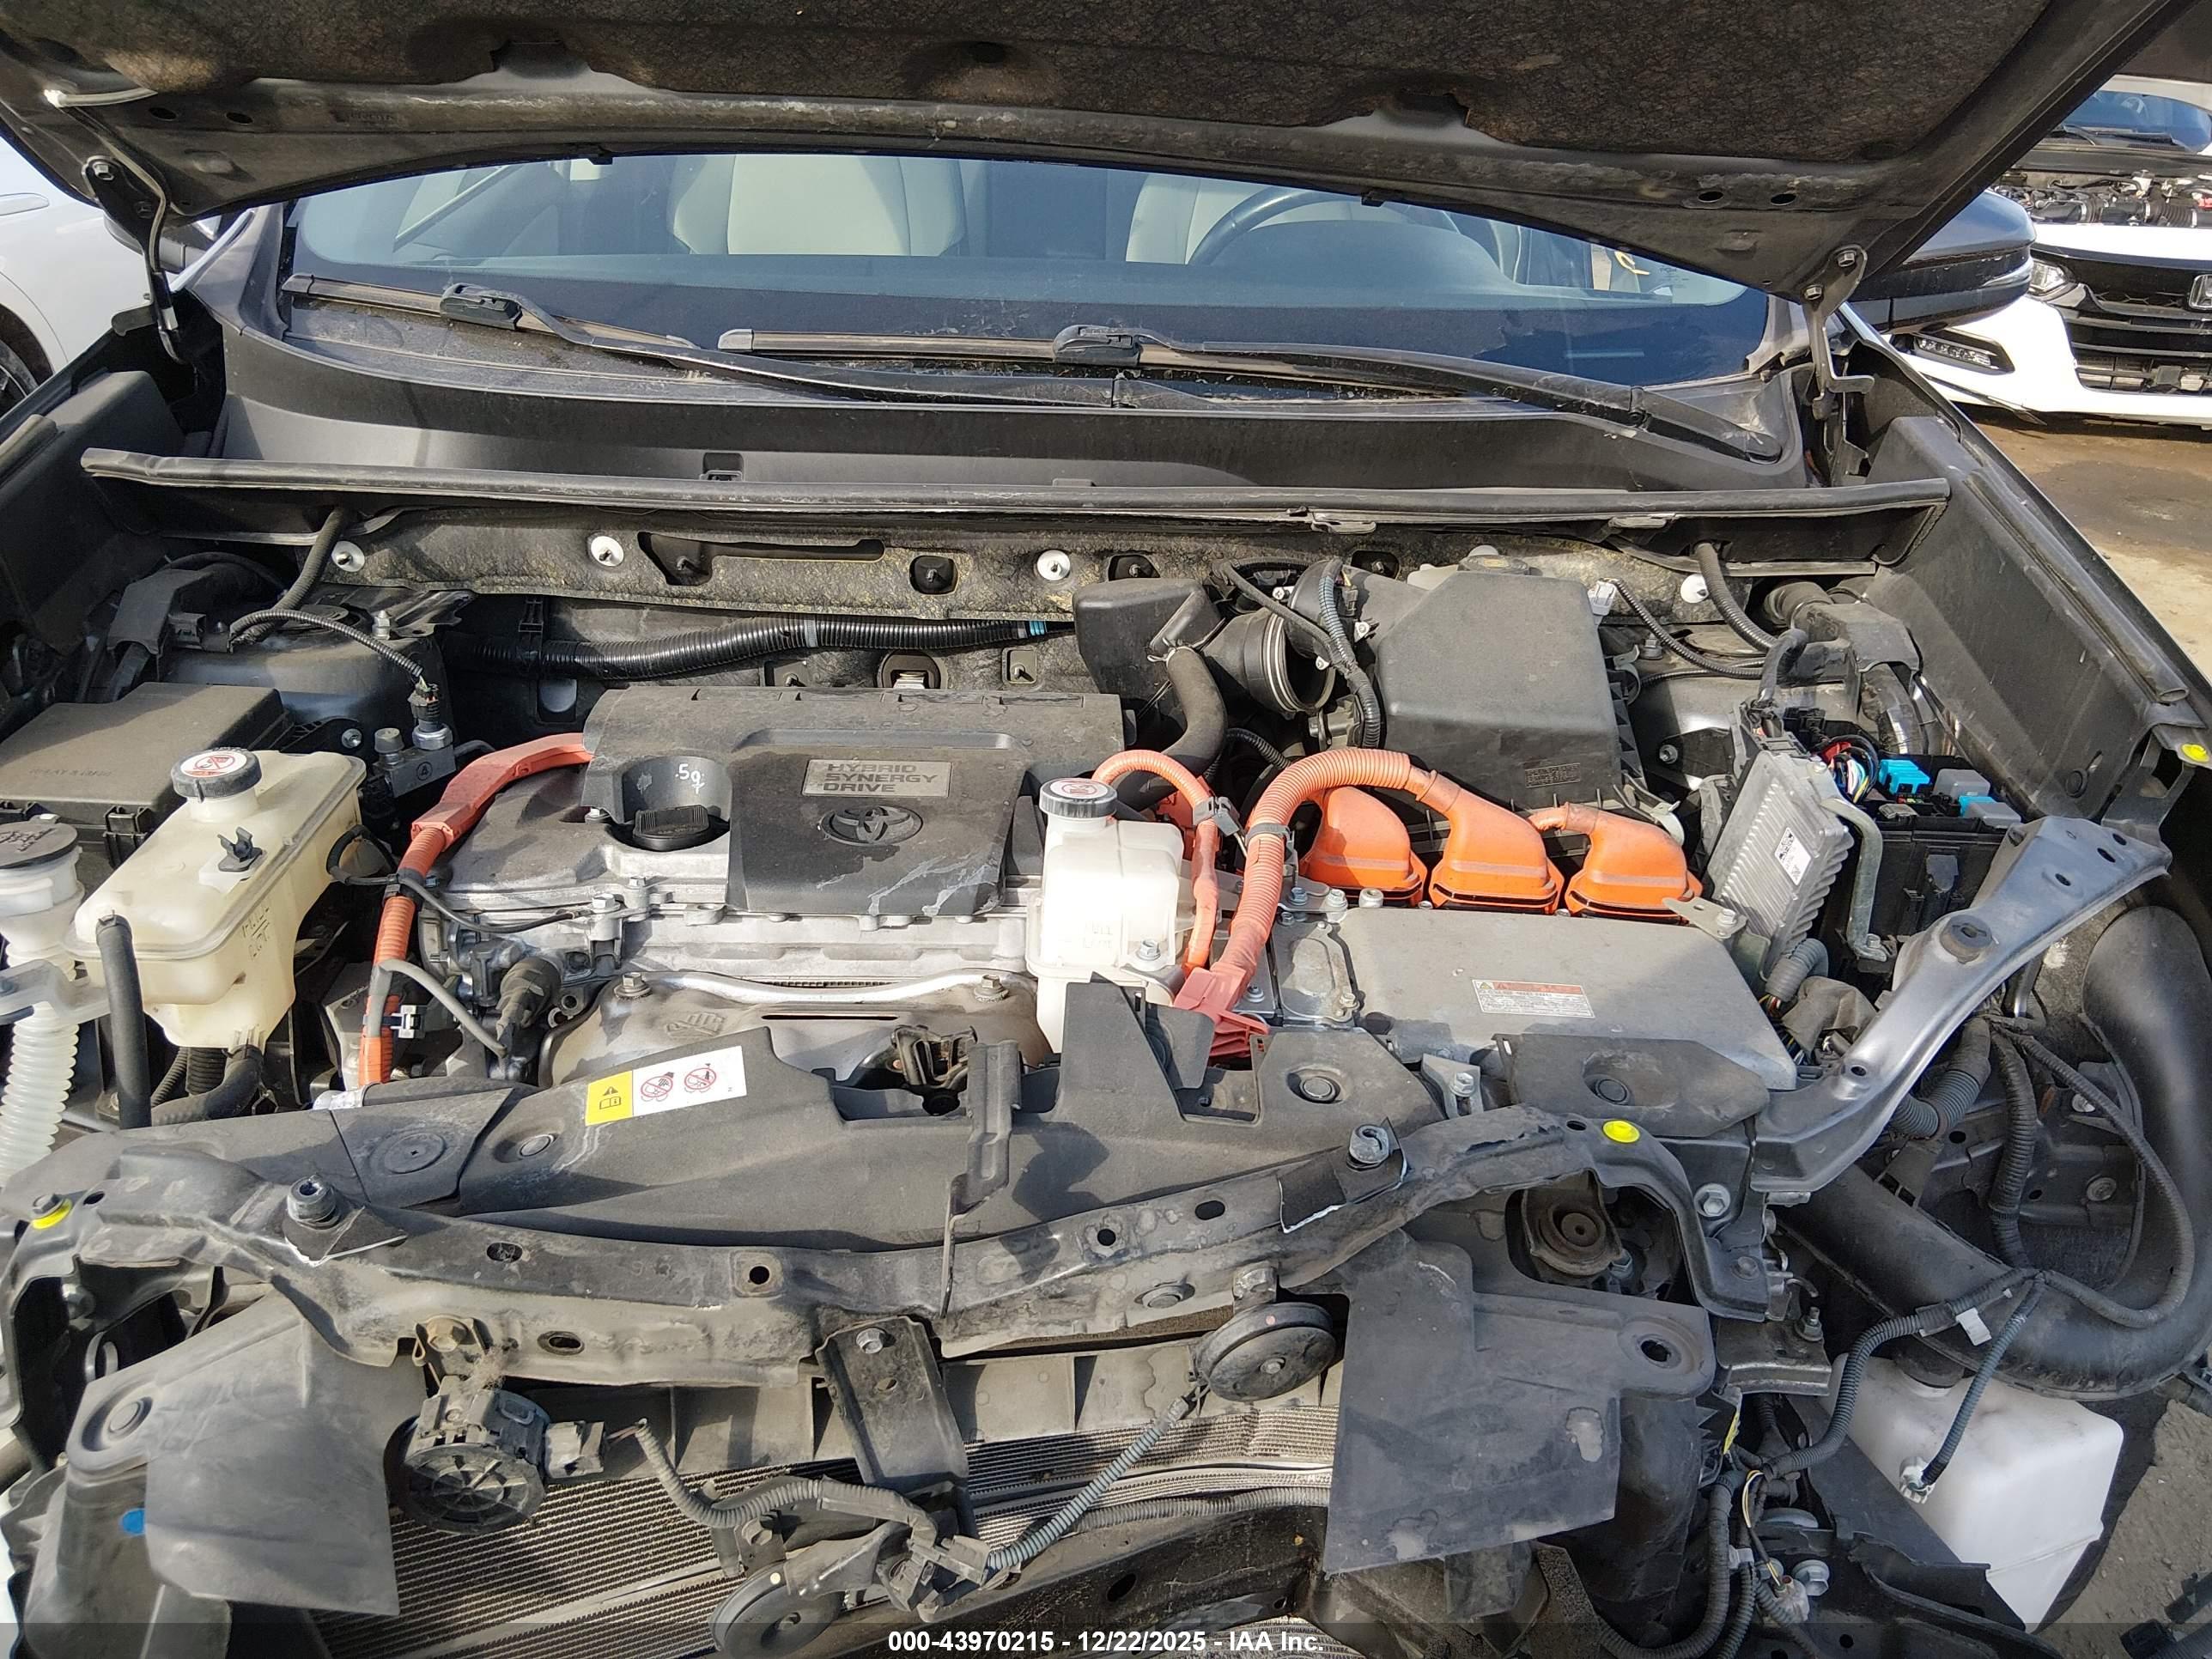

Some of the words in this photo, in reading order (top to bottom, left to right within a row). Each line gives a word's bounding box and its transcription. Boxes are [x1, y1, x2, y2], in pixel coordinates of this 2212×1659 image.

[827, 763, 917, 773] HYBRID
[824, 773, 939, 783] SYNERGY
[823, 783, 896, 793] DRIVE
